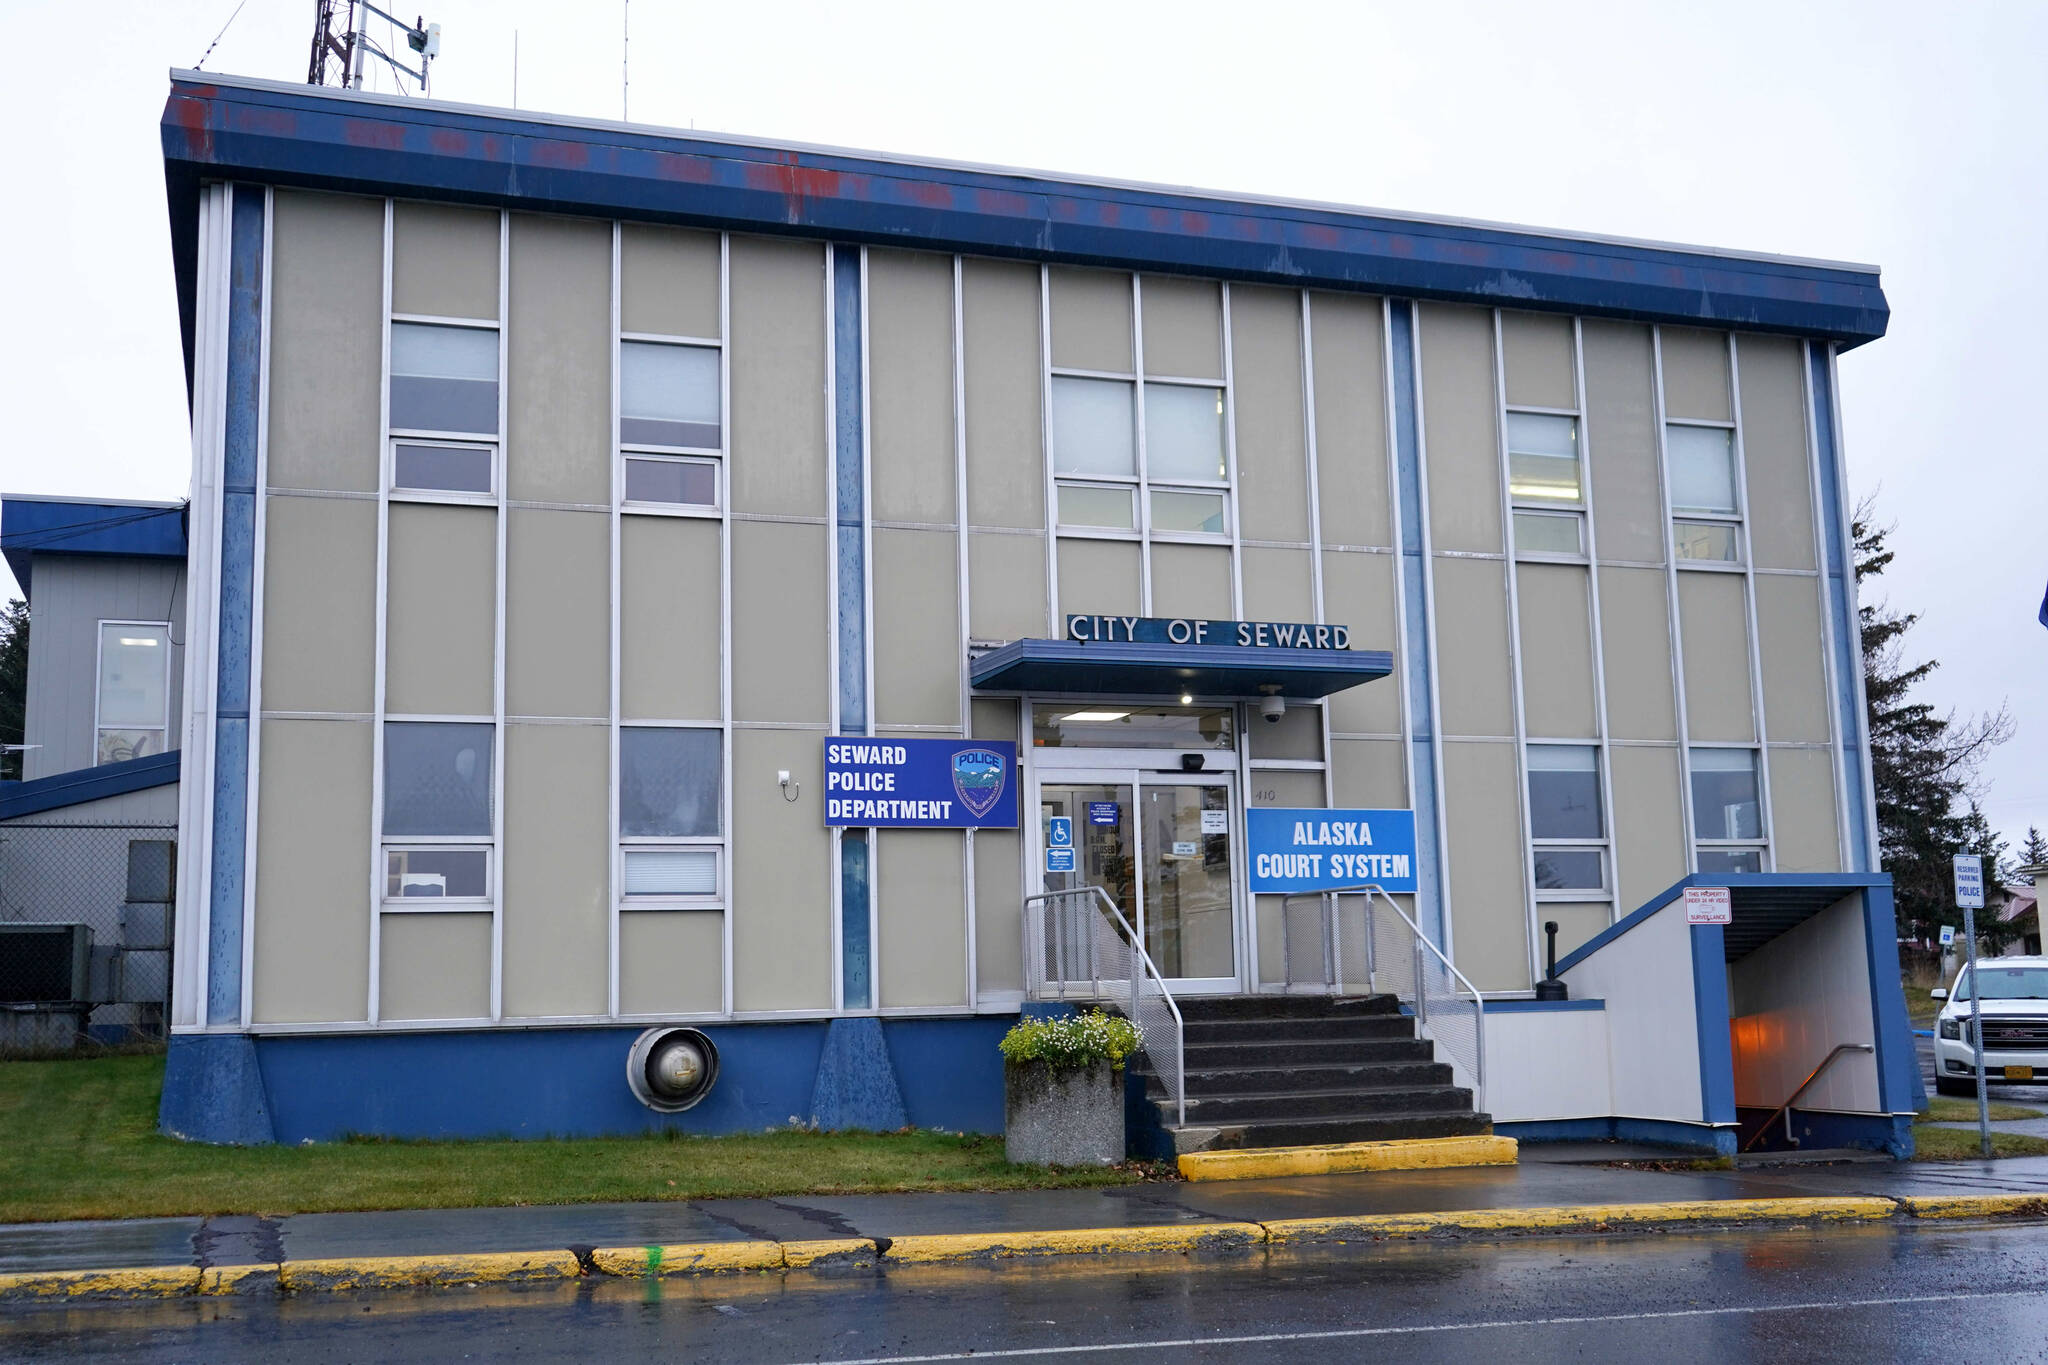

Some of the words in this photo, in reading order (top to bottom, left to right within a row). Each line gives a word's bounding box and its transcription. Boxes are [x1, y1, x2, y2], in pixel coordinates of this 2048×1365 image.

[1070, 616, 1138, 641] CITY
[1167, 619, 1208, 644] OF
[1237, 622, 1350, 650] SEWARD
[828, 744, 907, 765] SEWARD
[959, 752, 1000, 768] POLICE
[828, 771, 896, 792] POLICE
[1255, 790, 1276, 801] 410
[828, 799, 953, 819] DEPARTMENT
[1293, 821, 1374, 846] ALASKA
[1256, 853, 1323, 879] COURT
[1330, 854, 1411, 878] SYSTEM
[1958, 874, 1979, 882] PARKING
[1958, 886, 1980, 896] POLICE
